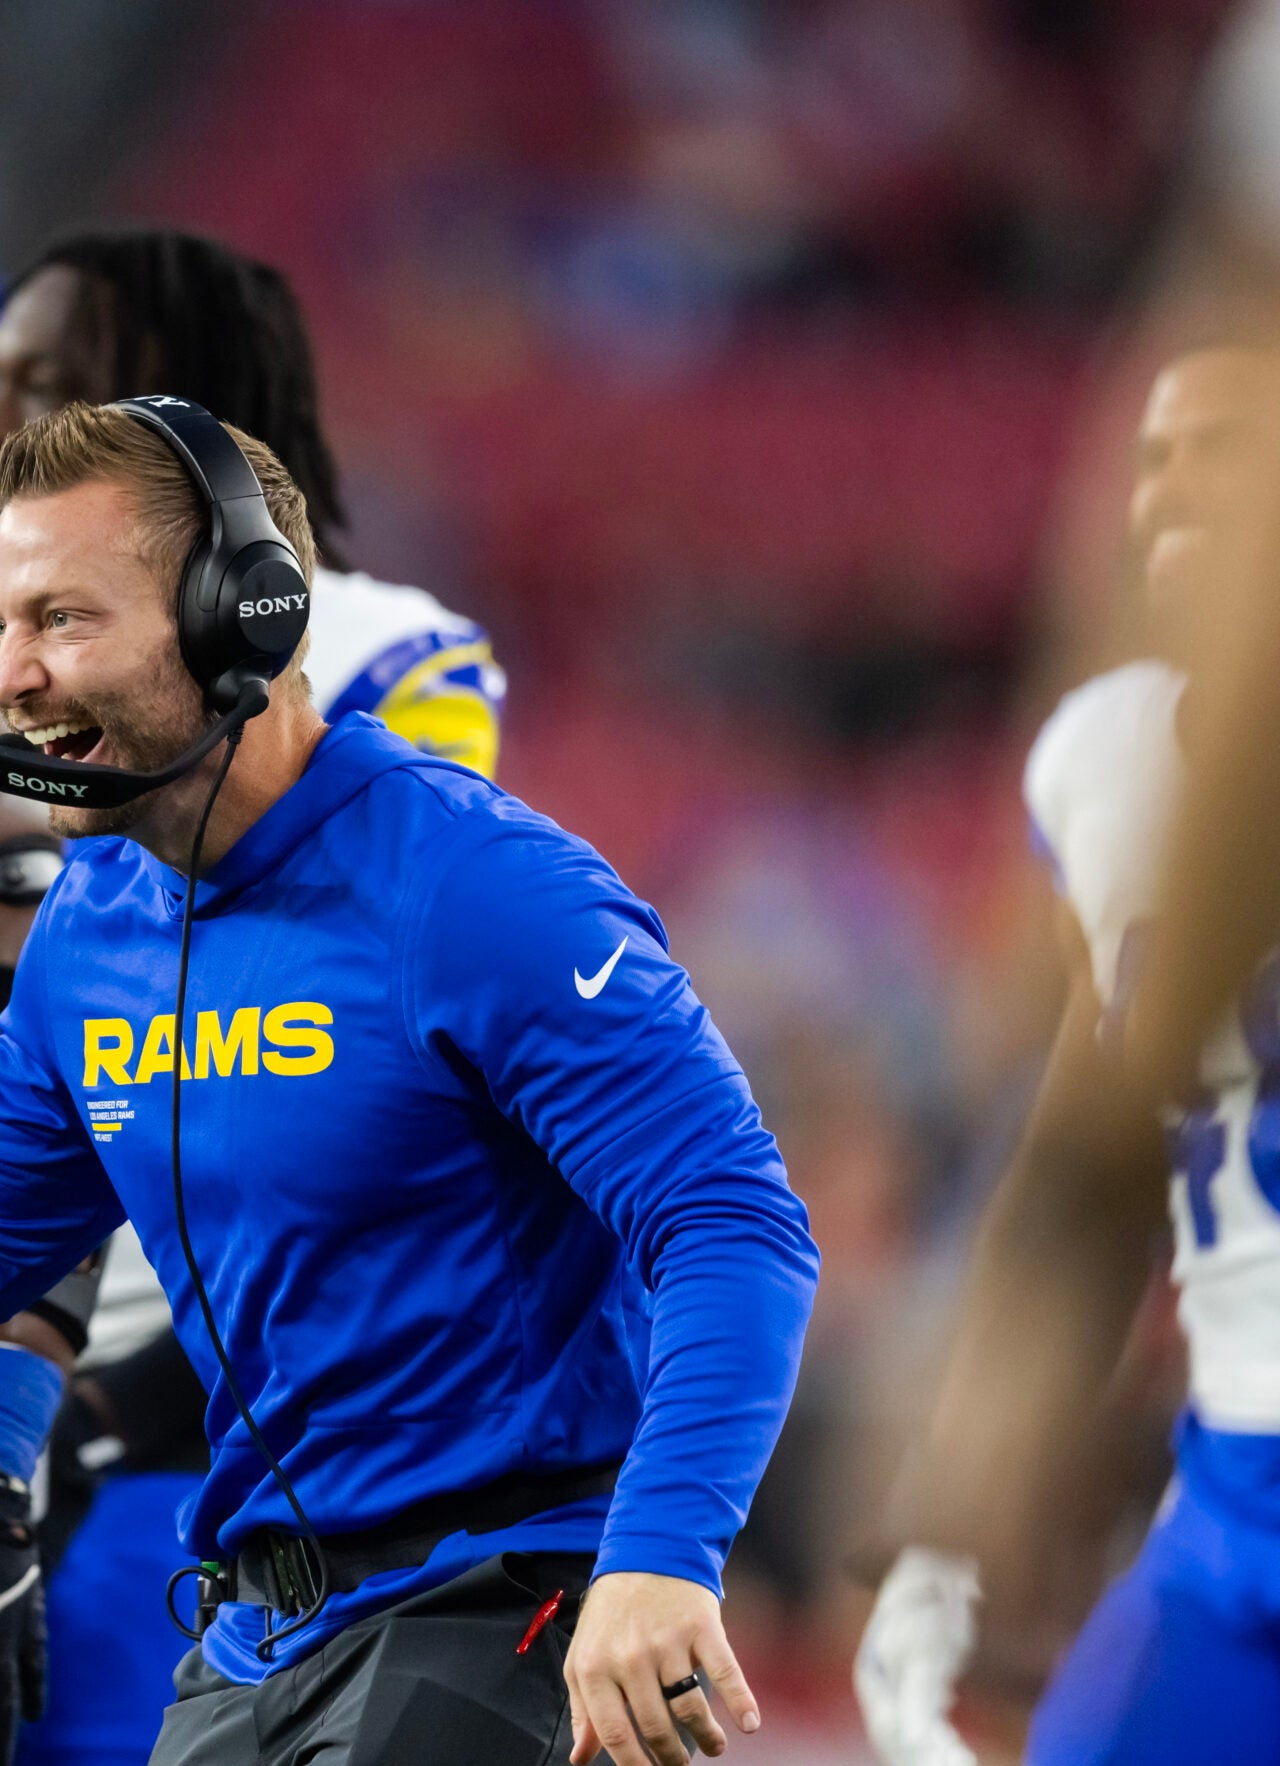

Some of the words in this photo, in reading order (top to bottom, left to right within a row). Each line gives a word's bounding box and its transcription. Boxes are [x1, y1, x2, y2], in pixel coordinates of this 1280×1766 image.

[238, 593, 308, 618] SONY
[7, 772, 88, 798] SONY
[83, 1001, 335, 1087] RAMS
[116, 1100, 129, 1109] FOR
[117, 1110, 135, 1120] RAMS
